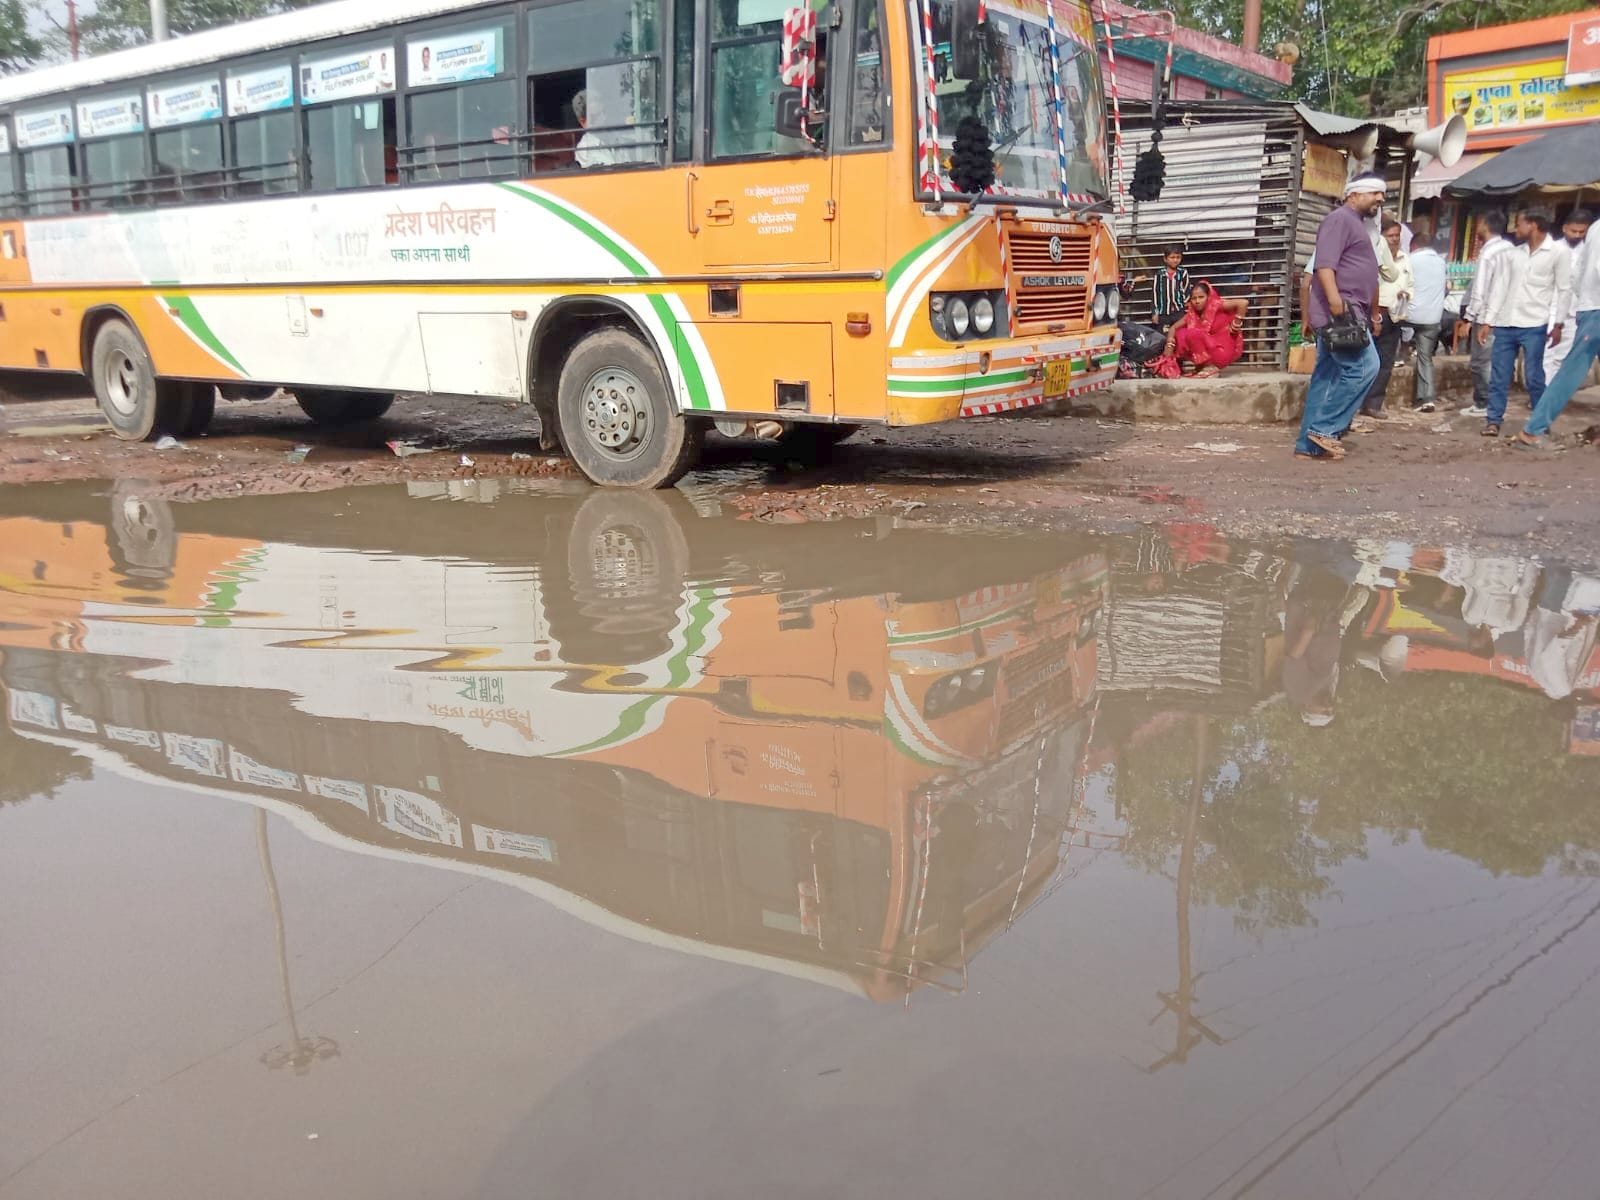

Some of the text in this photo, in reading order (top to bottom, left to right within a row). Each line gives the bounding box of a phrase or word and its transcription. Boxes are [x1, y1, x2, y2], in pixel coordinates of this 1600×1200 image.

[425, 200, 497, 237] परिवहन
[412, 247, 441, 263] अपना
[443, 243, 471, 263] साथी
[1023, 275, 1085, 287] ASHOK LEYLAND
